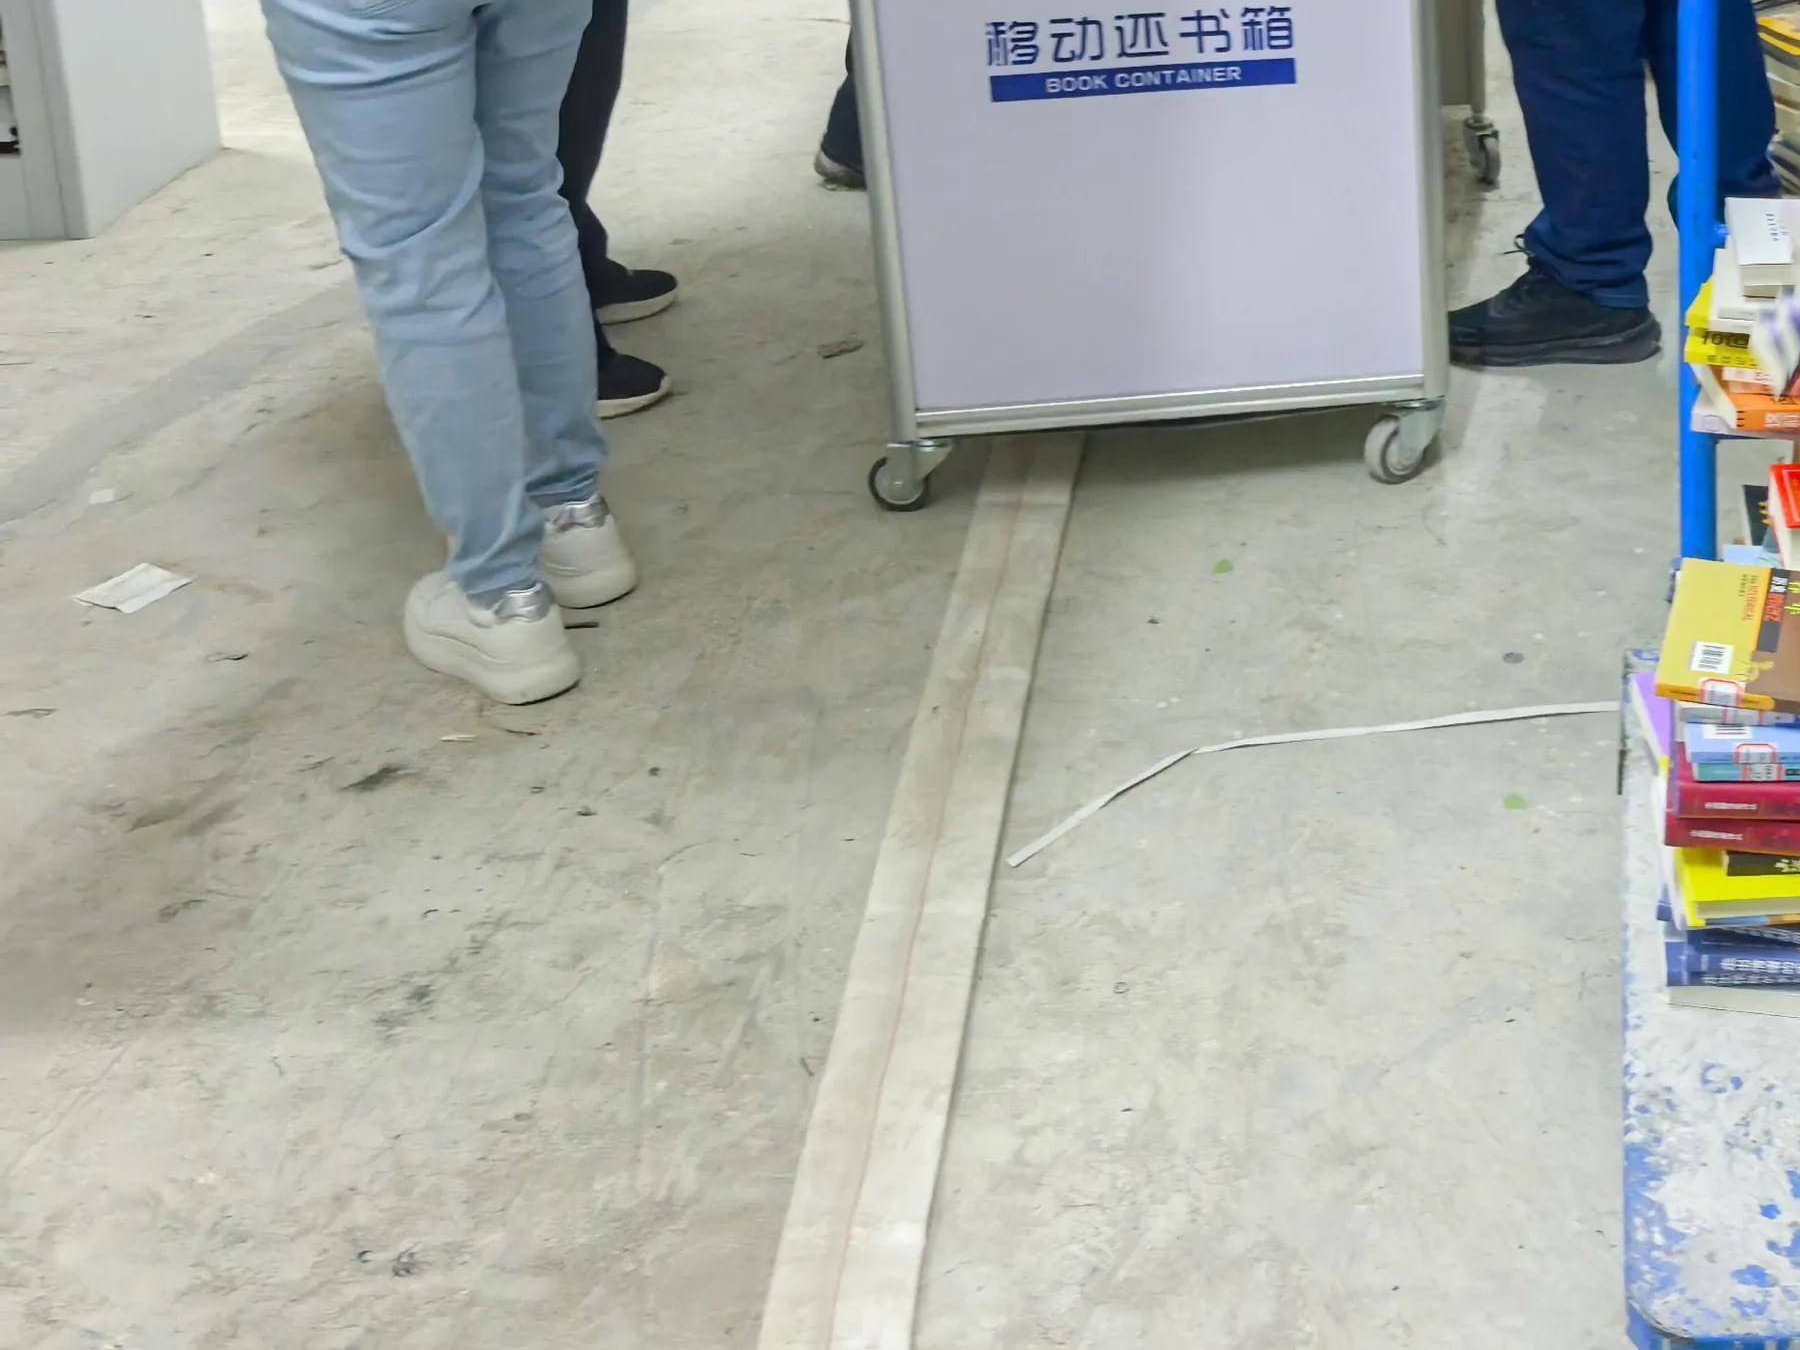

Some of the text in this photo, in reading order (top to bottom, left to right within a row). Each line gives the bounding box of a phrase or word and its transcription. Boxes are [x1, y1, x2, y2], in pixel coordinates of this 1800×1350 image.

[985, 5, 1295, 67] 移动还书箱
[1045, 65, 1243, 94] BOOK CONTAINER
